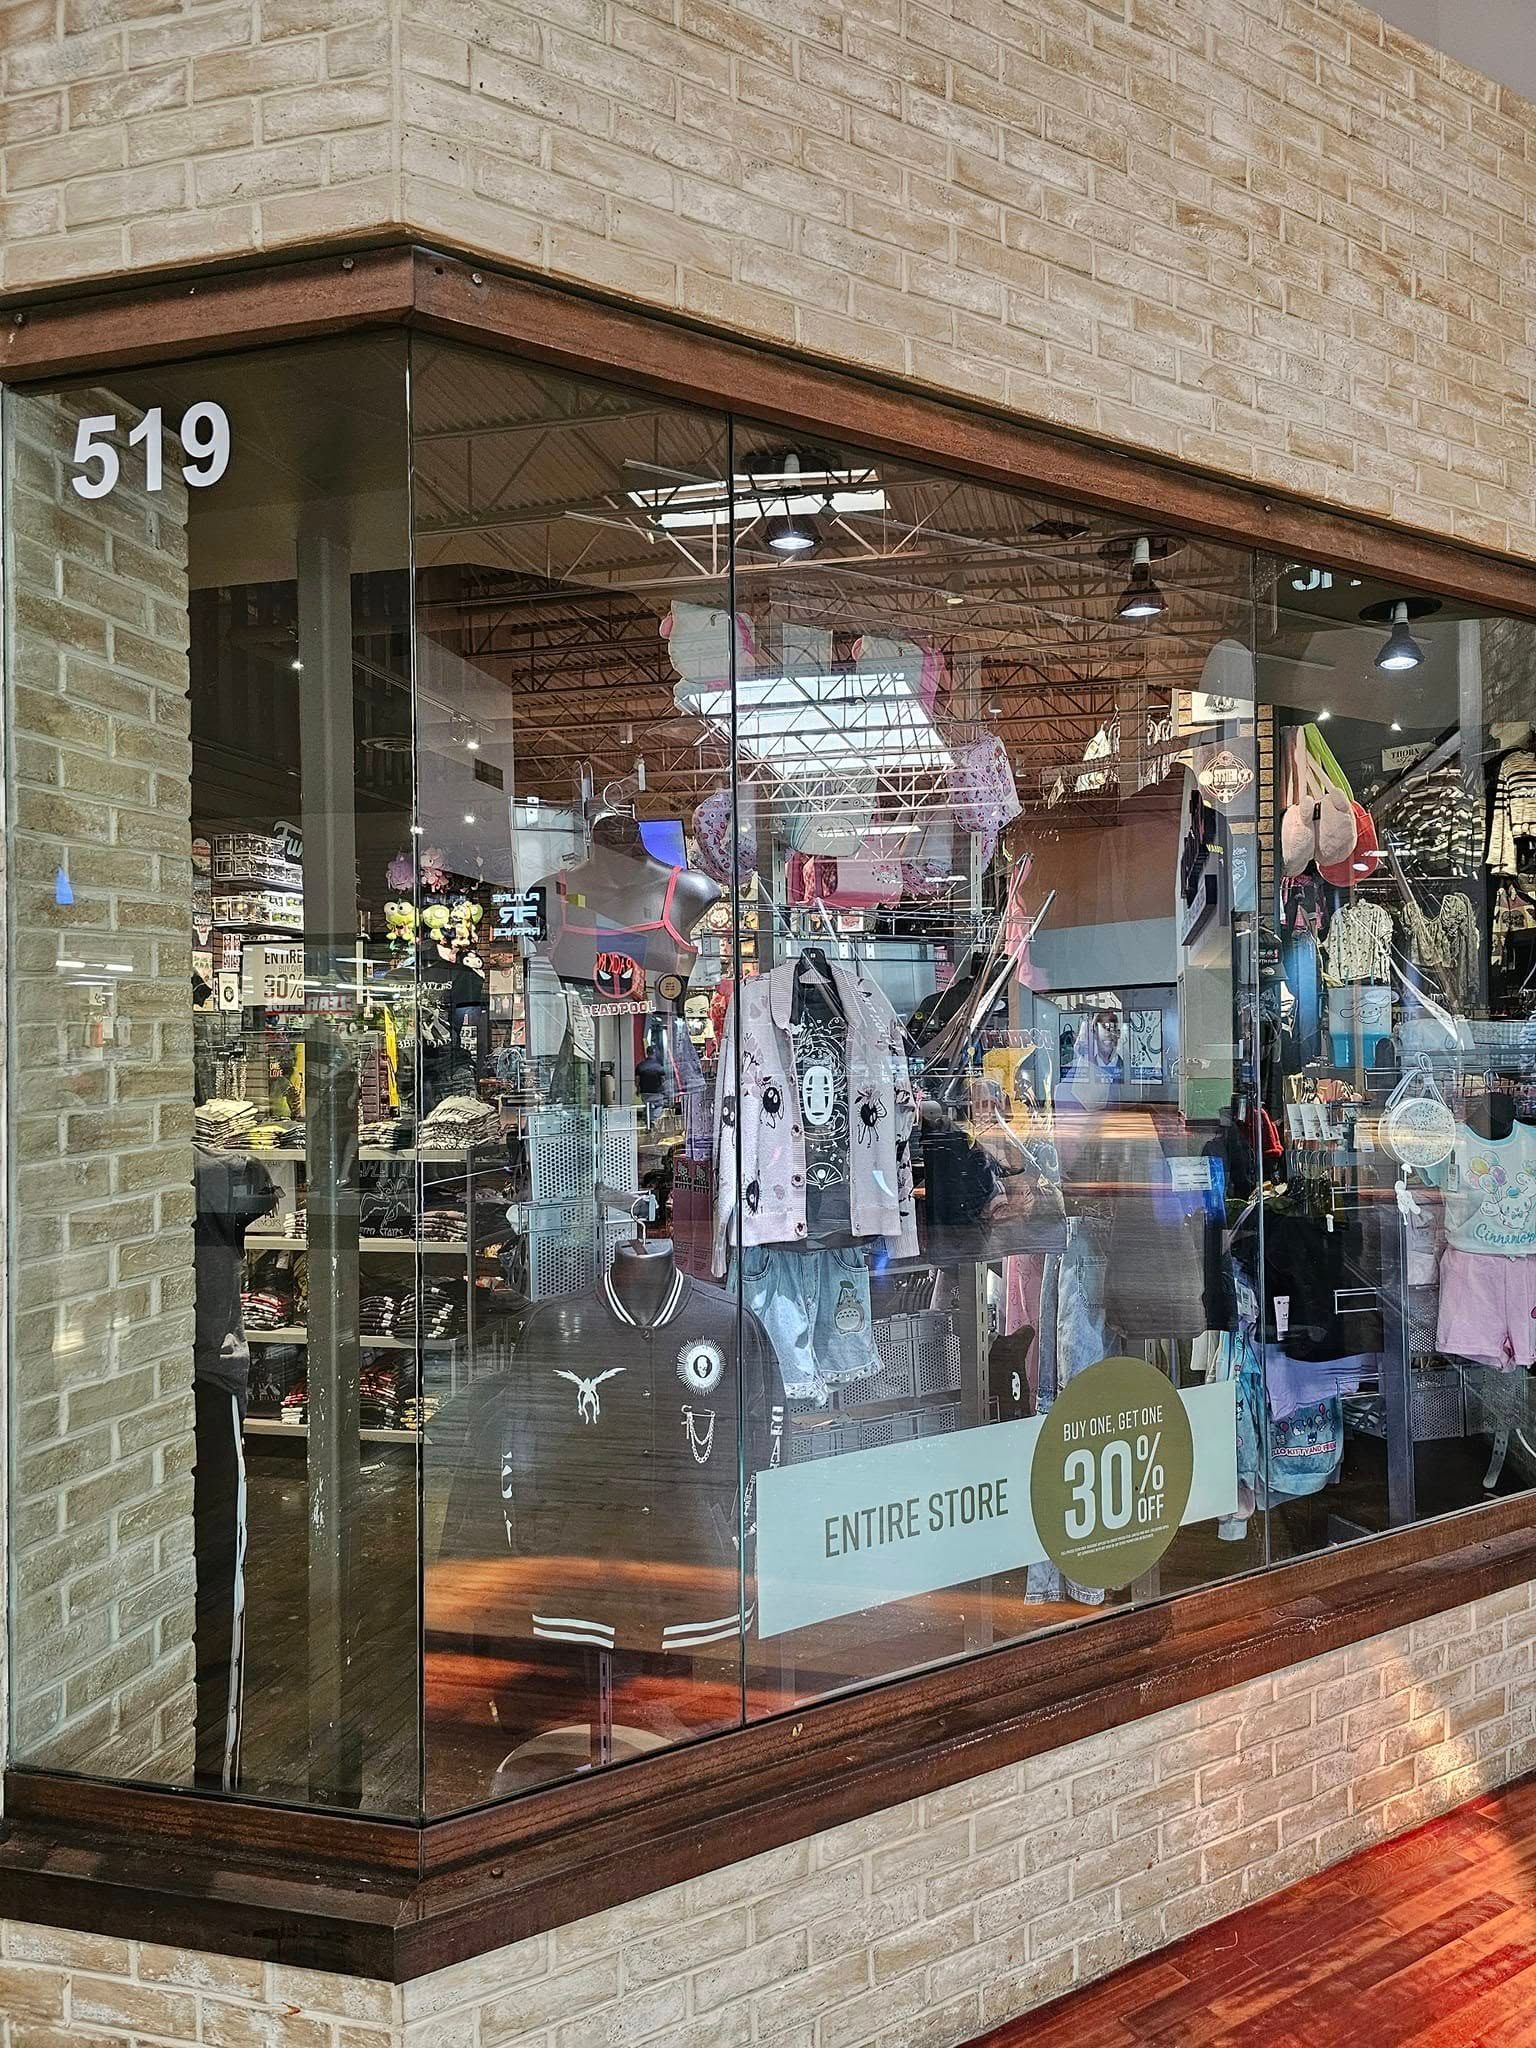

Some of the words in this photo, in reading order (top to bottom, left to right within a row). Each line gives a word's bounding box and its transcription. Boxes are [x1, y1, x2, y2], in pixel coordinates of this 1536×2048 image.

[72, 401, 231, 499] 519
[581, 1000, 657, 1016] DEADPOOL
[1063, 1419, 1087, 1442] BUY
[1089, 1414, 1116, 1437] ONE,
[1118, 1409, 1139, 1431] GET
[1141, 1405, 1164, 1426] ONE
[1287, 1447, 1310, 1456] KITTY
[1064, 1431, 1164, 1540] 30%
[825, 1498, 921, 1558] ENTIRE
[928, 1478, 1009, 1532] STORE
[1138, 1494, 1165, 1523] OFF
